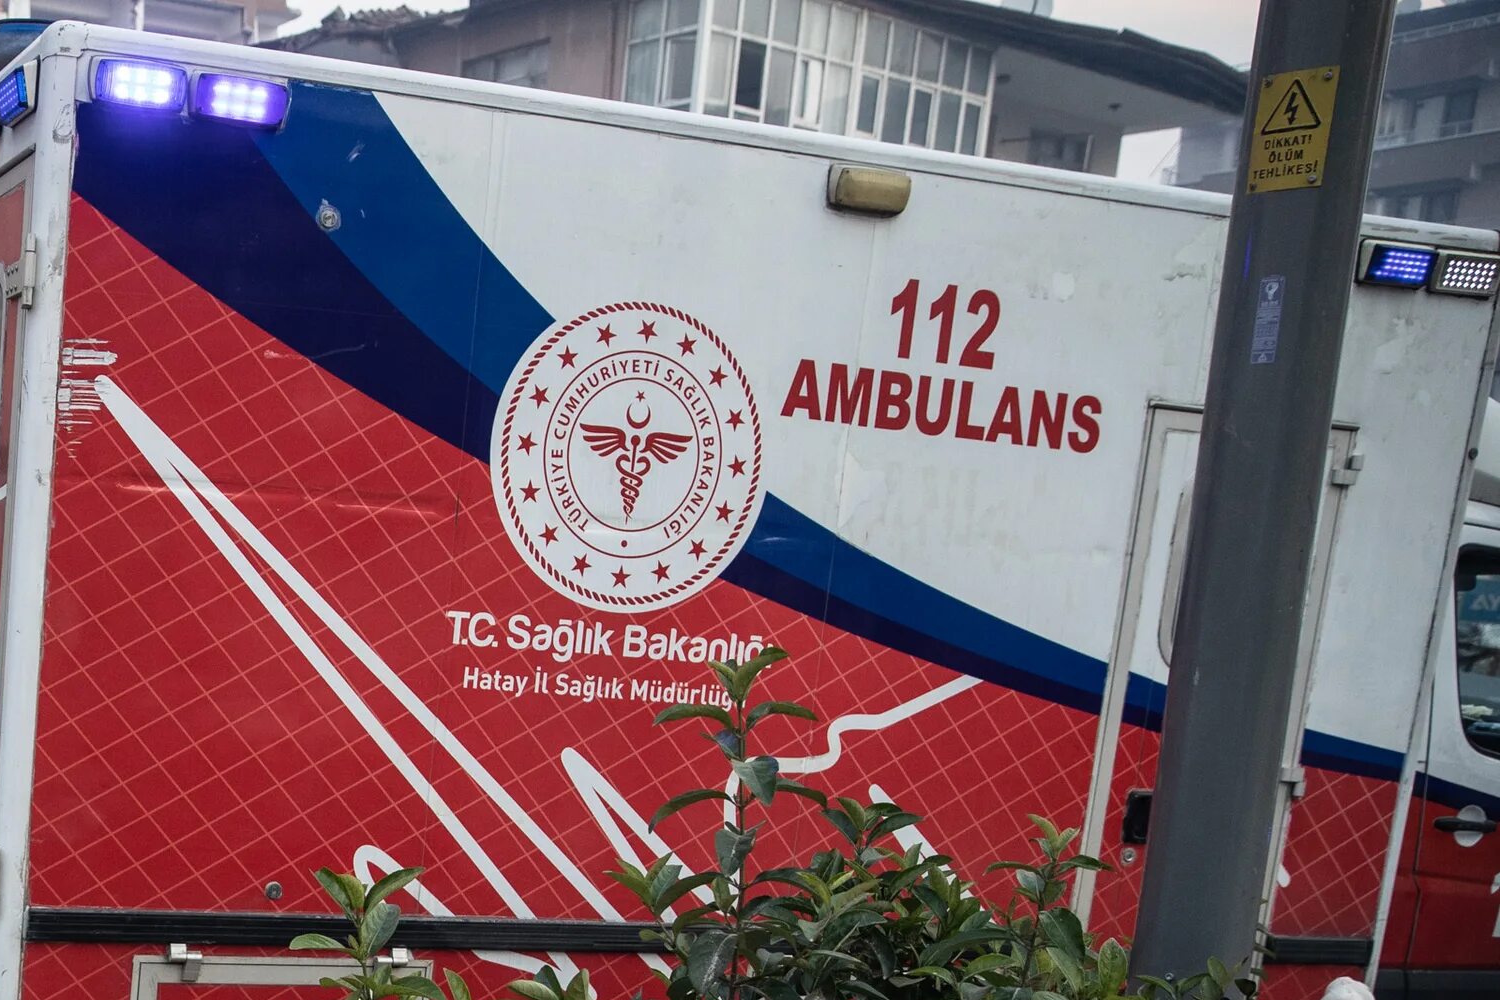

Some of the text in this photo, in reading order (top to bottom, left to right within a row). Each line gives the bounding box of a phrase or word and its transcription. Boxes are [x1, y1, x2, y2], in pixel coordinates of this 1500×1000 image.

[1268, 148, 1304, 164] ÖLÜM
[890, 279, 1001, 370] 112
[780, 358, 1103, 454] AMBULANS
[551, 359, 715, 540] TÜRKİYE CUMHURİYETİ SAĞLIK BAKANLIĞI
[506, 613, 615, 663] Sağlık
[463, 666, 529, 696] Hatay
[534, 665, 549, 694] İl
[555, 672, 624, 704] Sağlık
